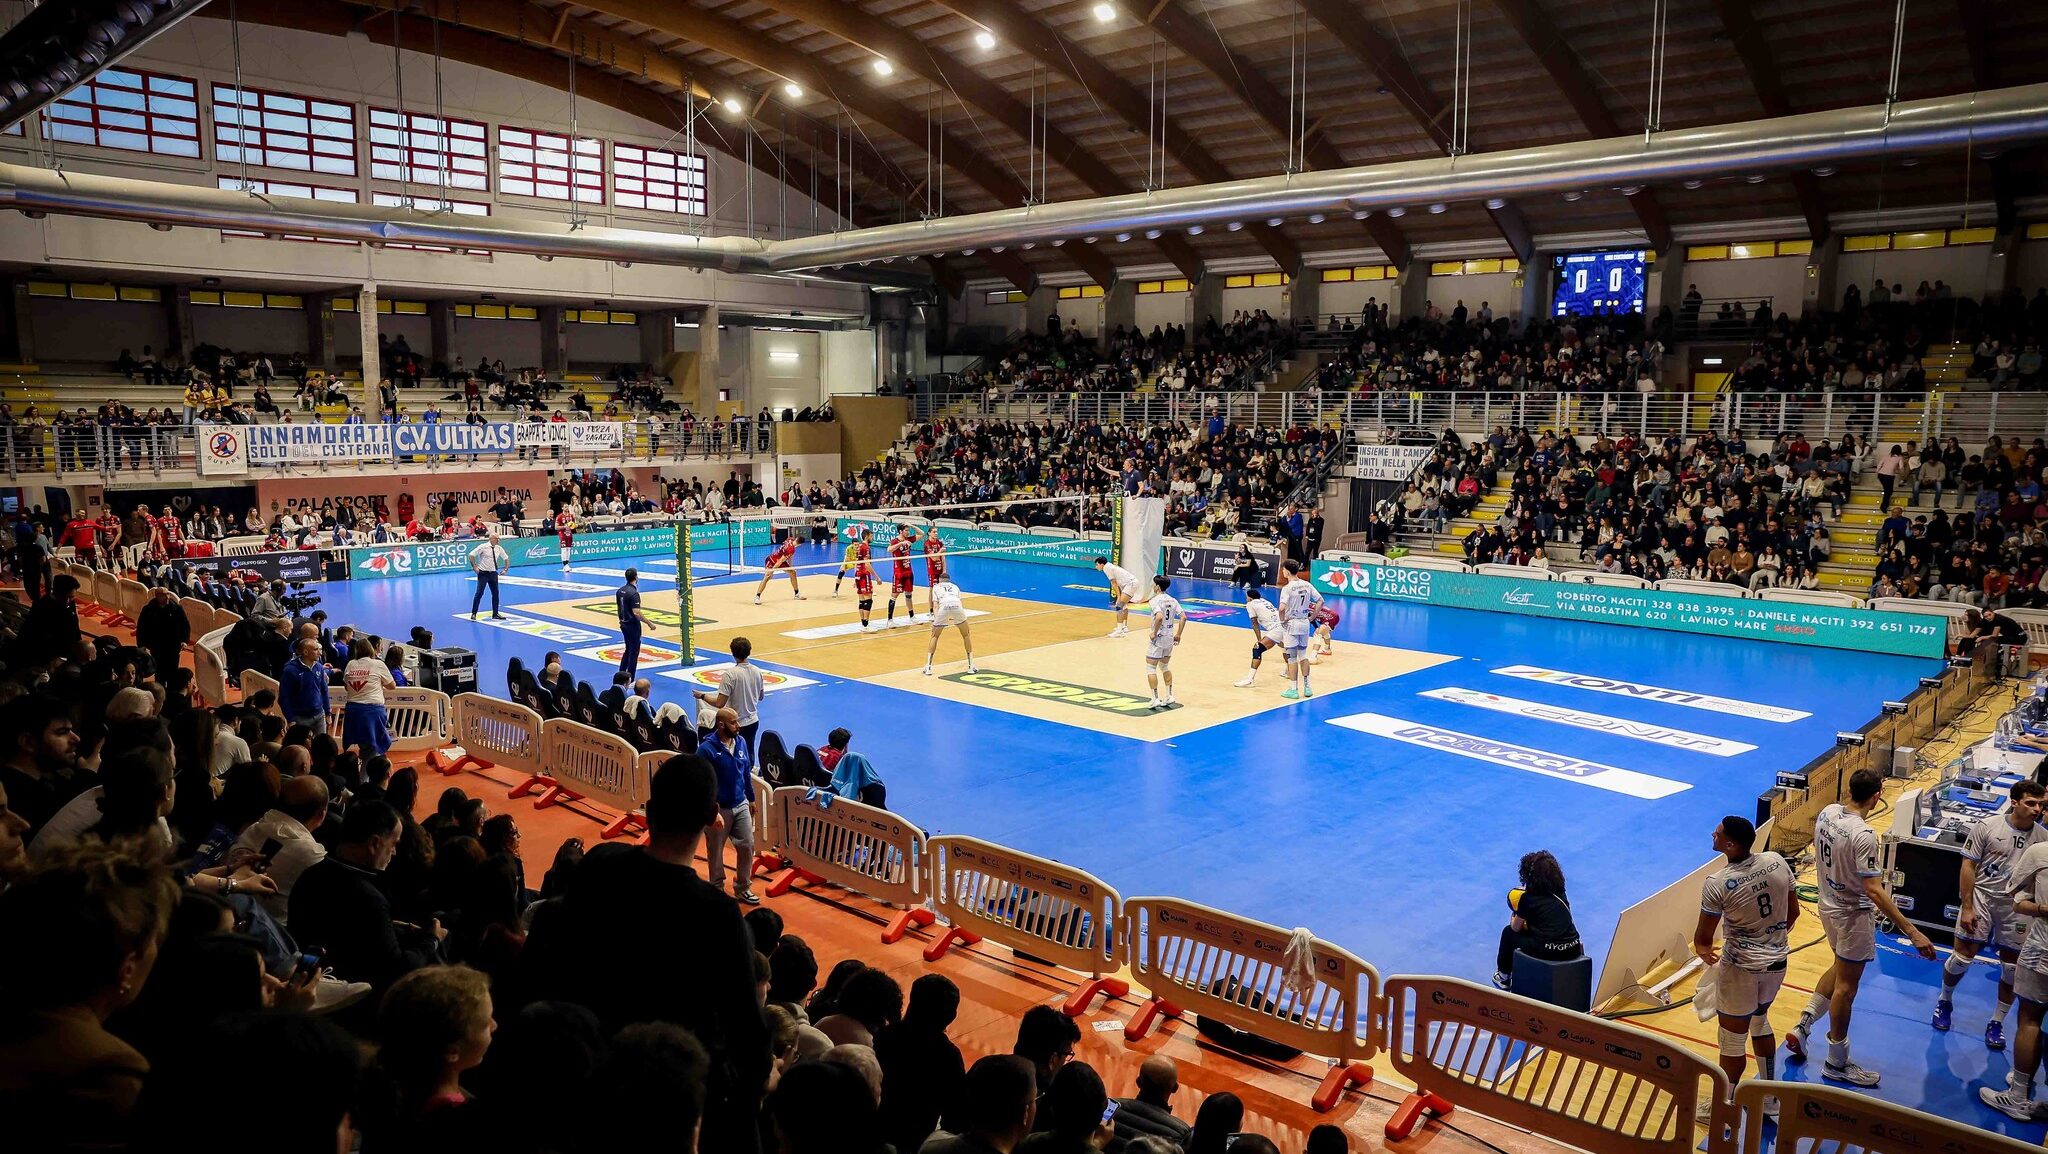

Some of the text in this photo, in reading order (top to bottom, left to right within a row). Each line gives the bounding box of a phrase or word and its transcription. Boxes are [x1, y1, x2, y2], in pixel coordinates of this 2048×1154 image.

[1575, 267, 1622, 293] 0 0
[203, 425, 241, 437] VIETATO
[249, 425, 389, 445] INNAMORATI
[548, 424, 567, 441] VINCI
[587, 425, 611, 433] FORZA
[395, 423, 511, 451] C.V. ULTRAS
[586, 433, 614, 441] RAGAZZI
[251, 443, 390, 459] SOLO DEL CISTERNA
[1360, 446, 1389, 457] INSIEME
[1392, 448, 1400, 457] IN
[207, 455, 241, 465] GUFARE
[1360, 457, 1378, 466] UNITI
[1382, 458, 1406, 468] NELLA
[1358, 467, 1386, 477] FORZA
[480, 490, 492, 503] DI
[493, 488, 532, 502] LTINA
[872, 522, 897, 535] BORG
[582, 546, 620, 555] ARDEATINA
[644, 541, 671, 549] LAVINIO
[601, 537, 624, 545] NACITI
[968, 536, 994, 544] ROBERTO
[1066, 545, 1091, 554] DANIELE
[1093, 547, 1113, 556] NACIT
[417, 543, 467, 558] BORGO
[424, 555, 467, 568] ARANCI
[1375, 567, 1431, 586] BORGO
[1383, 583, 1430, 597] ARANCI
[1299, 594, 1305, 606] 7
[1165, 609, 1170, 621] 9
[1556, 591, 1936, 635] ROBERTO NACITI 328 838 3995 DANIELE NACITI 392 651 1747
[1557, 602, 1575, 611] VIA
[1581, 604, 1640, 618] ARDEATINA
[1645, 611, 1667, 620] 620
[1681, 614, 1729, 626] LAVINIO
[1734, 619, 1767, 631] MARE
[959, 673, 1155, 711] CREDEM
[1394, 727, 1591, 777] netweek
[2012, 835, 2025, 849] 16
[1738, 861, 1781, 885] GRUPPO GESA
[1751, 880, 1769, 893] PLAK
[1757, 892, 1772, 919] 8
[1446, 996, 1470, 1009] MARINI
[1570, 1032, 1596, 1046] LogUp
[1823, 1108, 1857, 1124] MARINI
